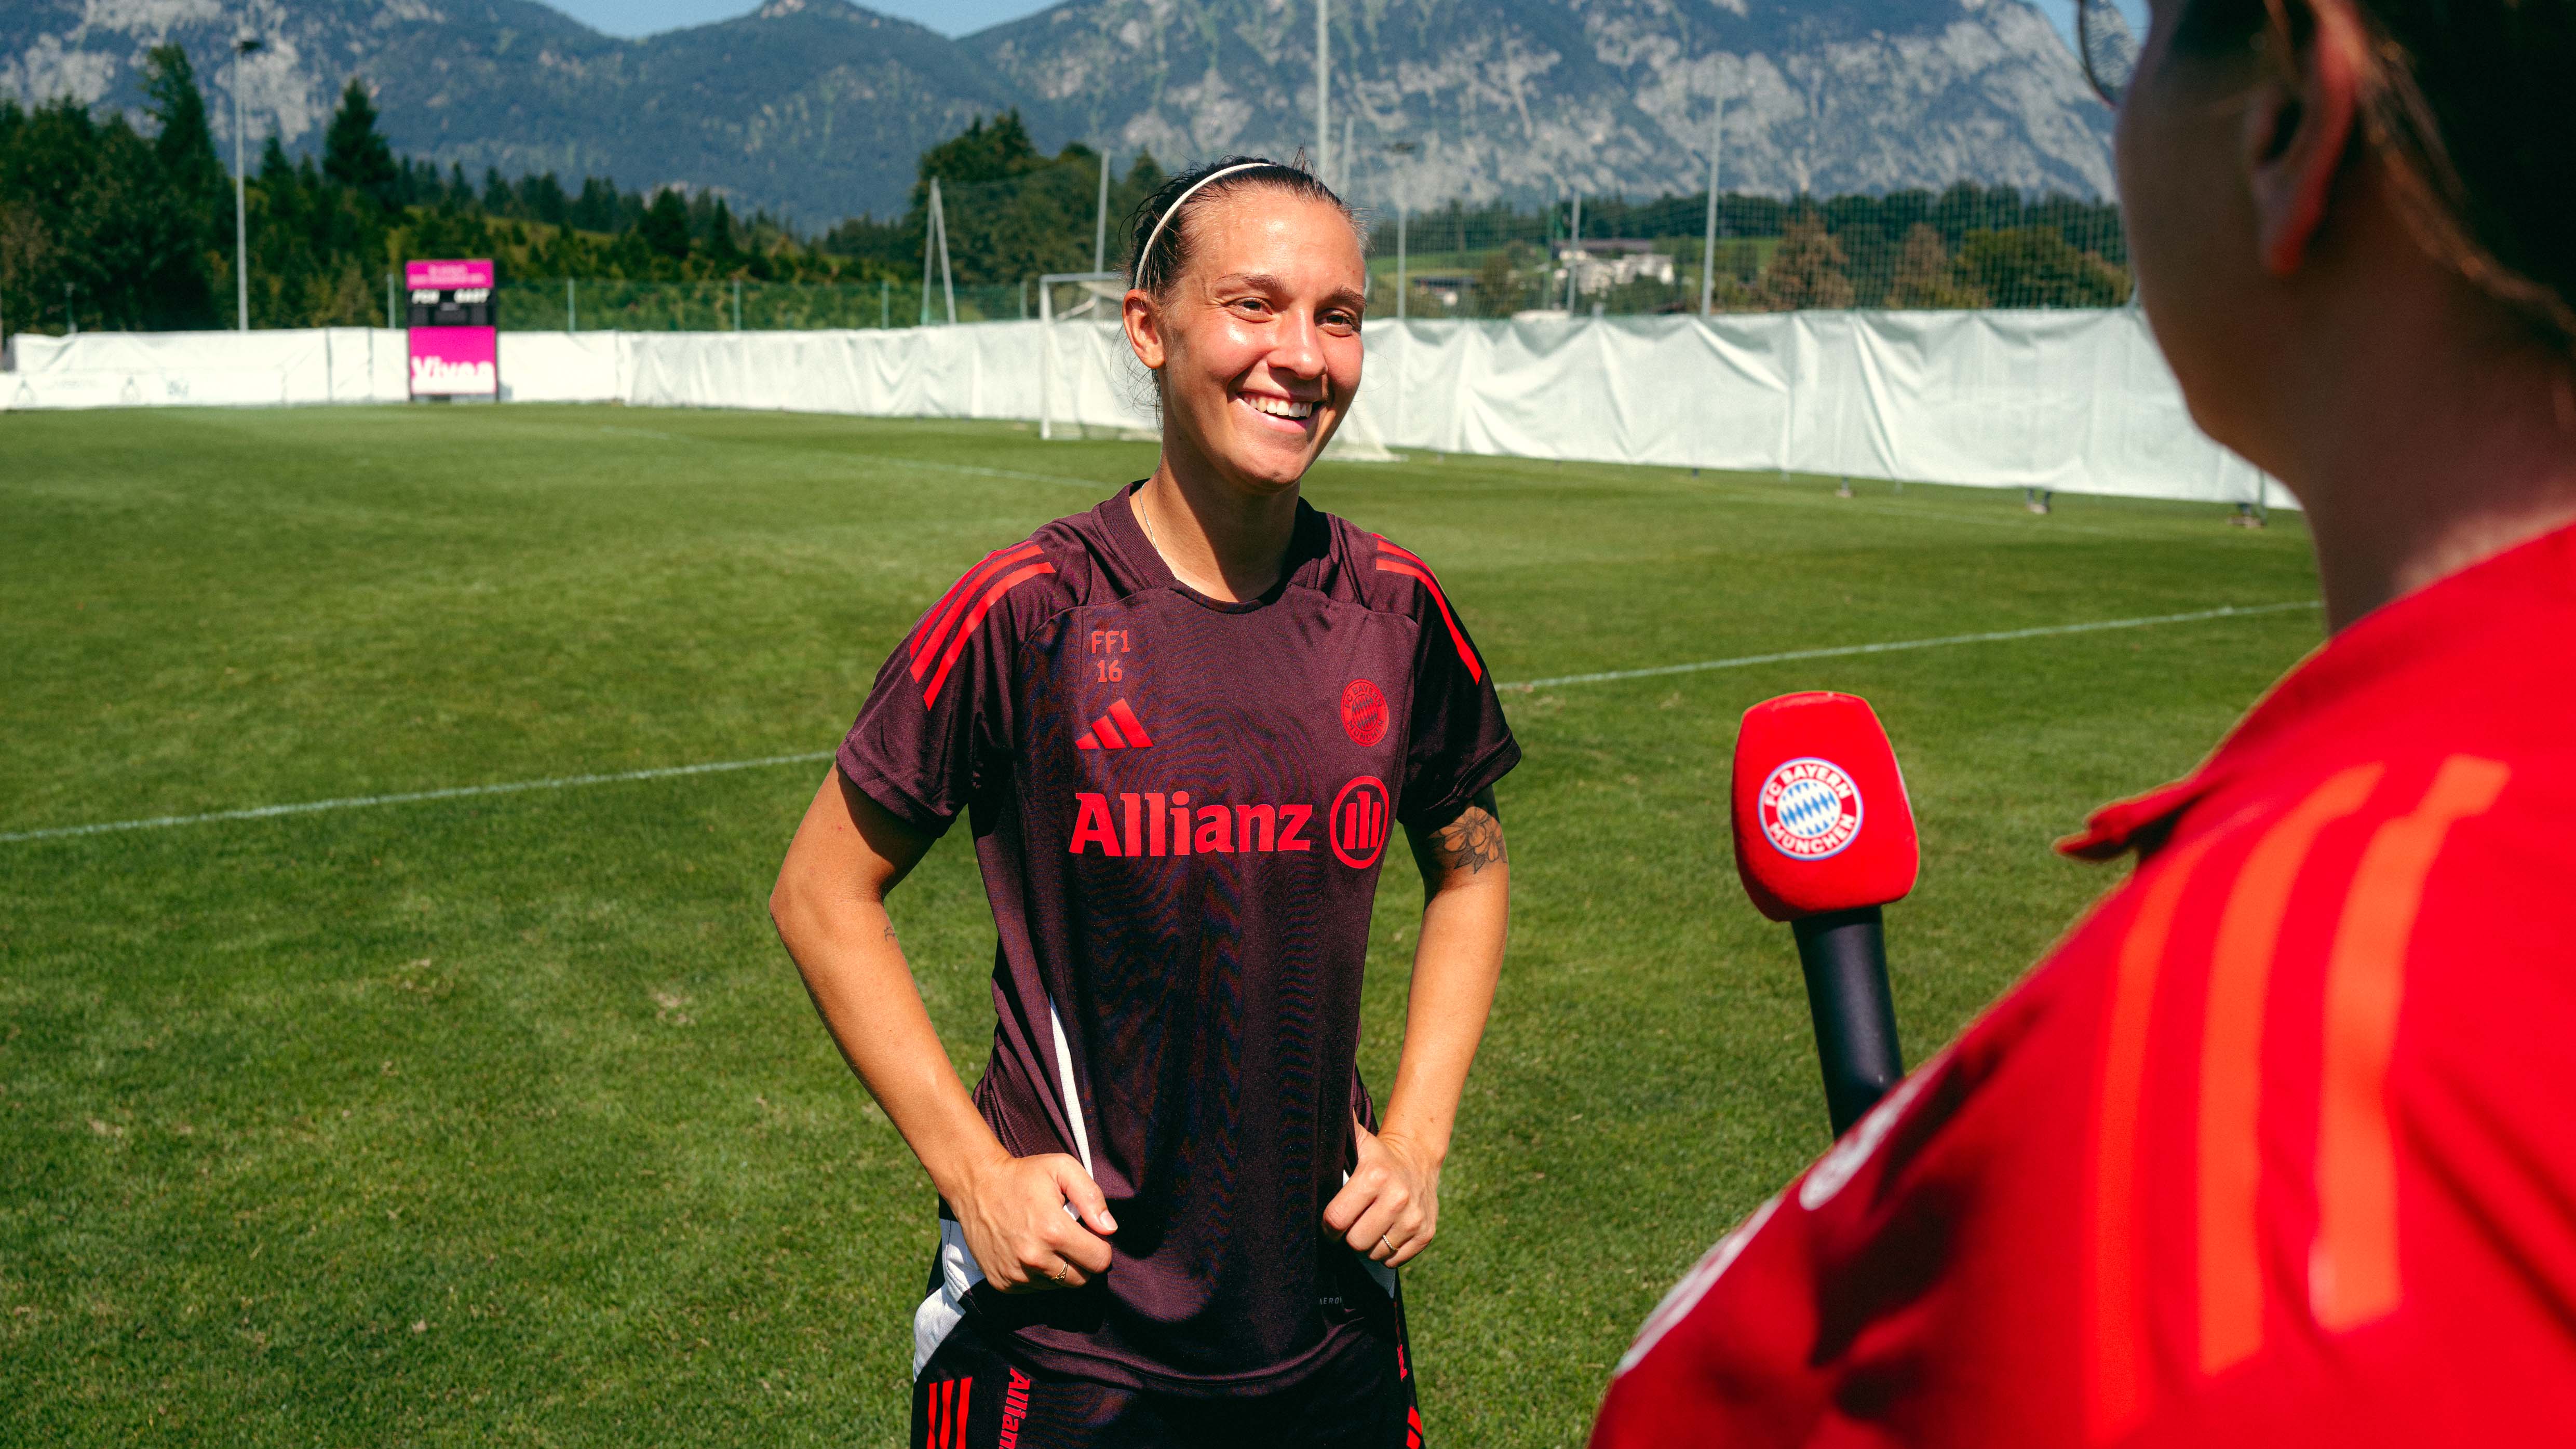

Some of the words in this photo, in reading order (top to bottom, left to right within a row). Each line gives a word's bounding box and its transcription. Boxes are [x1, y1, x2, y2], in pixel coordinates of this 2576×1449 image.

[1091, 630, 1130, 654] FF1
[1097, 659, 1123, 683] 16
[1344, 693, 1353, 709] FC
[1352, 684, 1383, 707] BAYERN
[1765, 781, 1783, 807] FC
[1779, 764, 1852, 800] BAYERN
[1068, 790, 1313, 857] Allianz
[999, 1367, 1031, 1449] Allian
